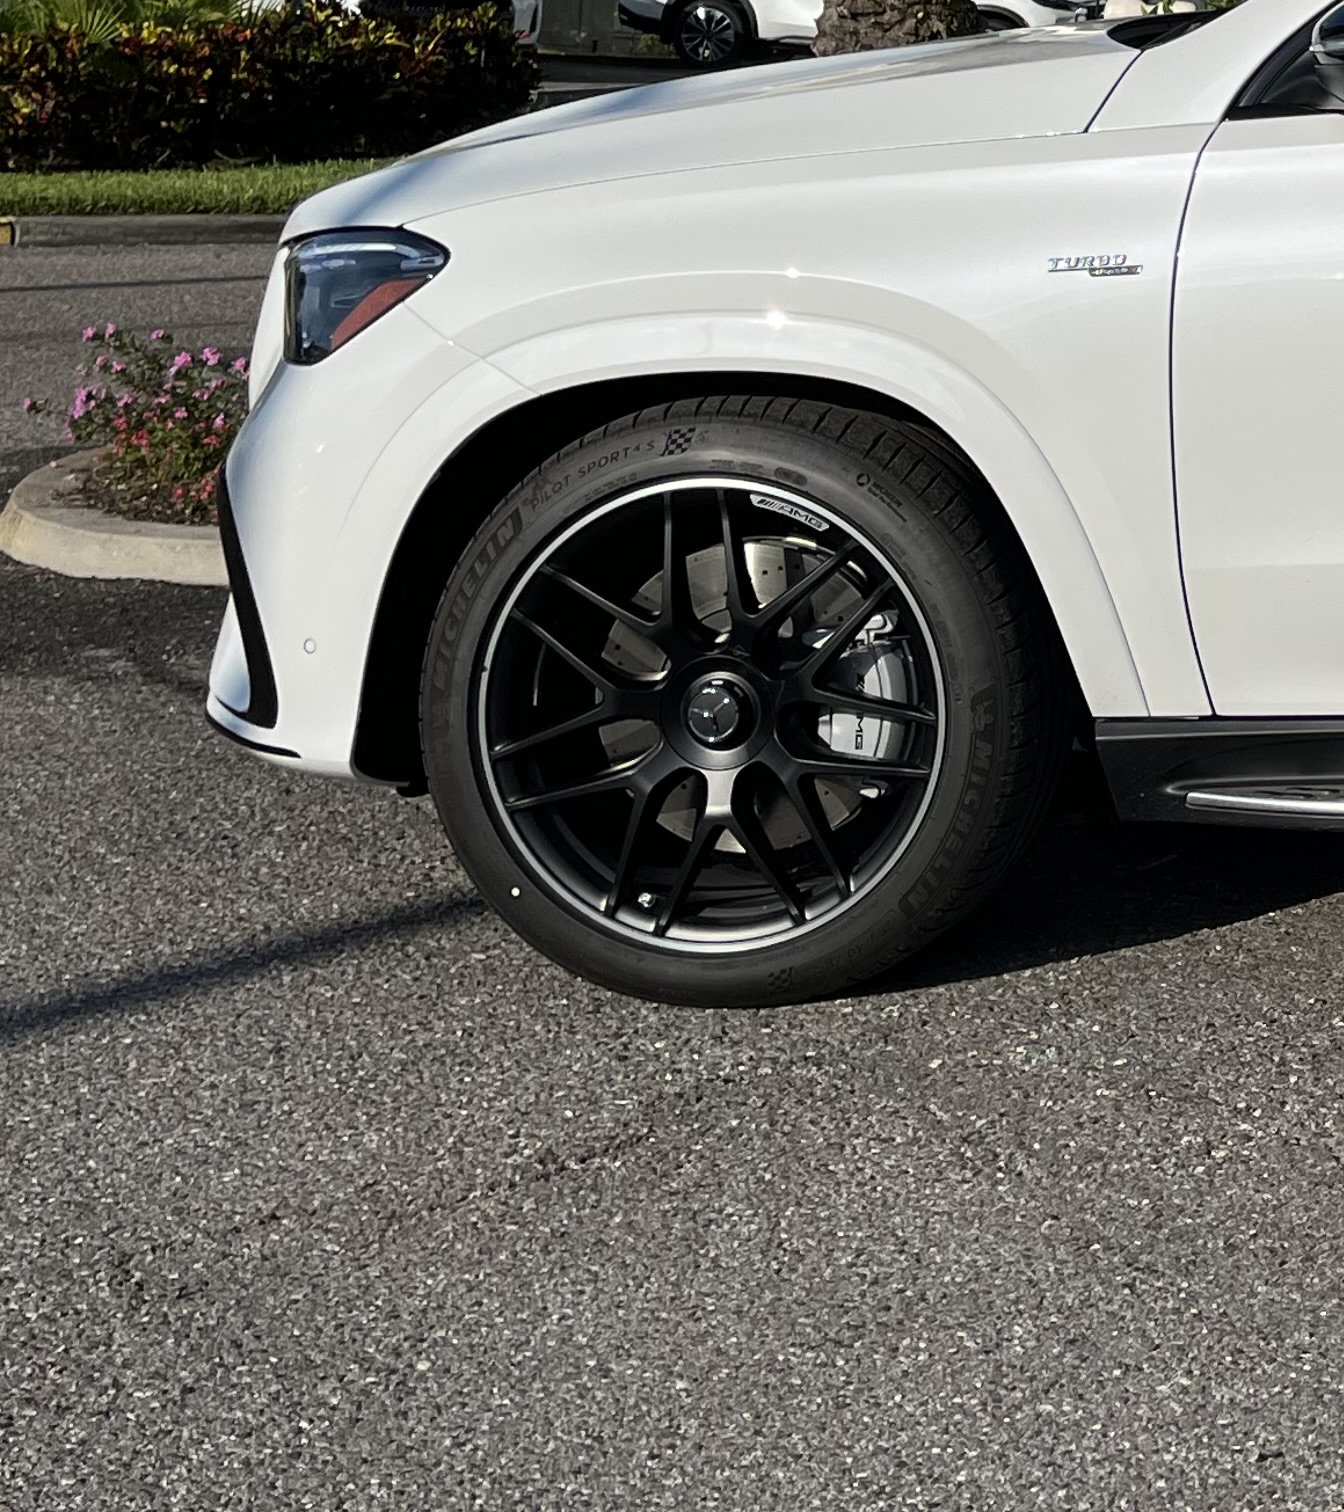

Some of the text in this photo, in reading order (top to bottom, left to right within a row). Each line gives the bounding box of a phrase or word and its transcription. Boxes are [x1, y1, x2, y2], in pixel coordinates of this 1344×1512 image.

[1047, 254, 1127, 269] TURBO
[531, 474, 570, 510] PILOT
[578, 447, 630, 479] SPORT
[646, 440, 655, 450] S
[778, 503, 823, 529] AMG
[431, 518, 516, 693] MICHELIN
